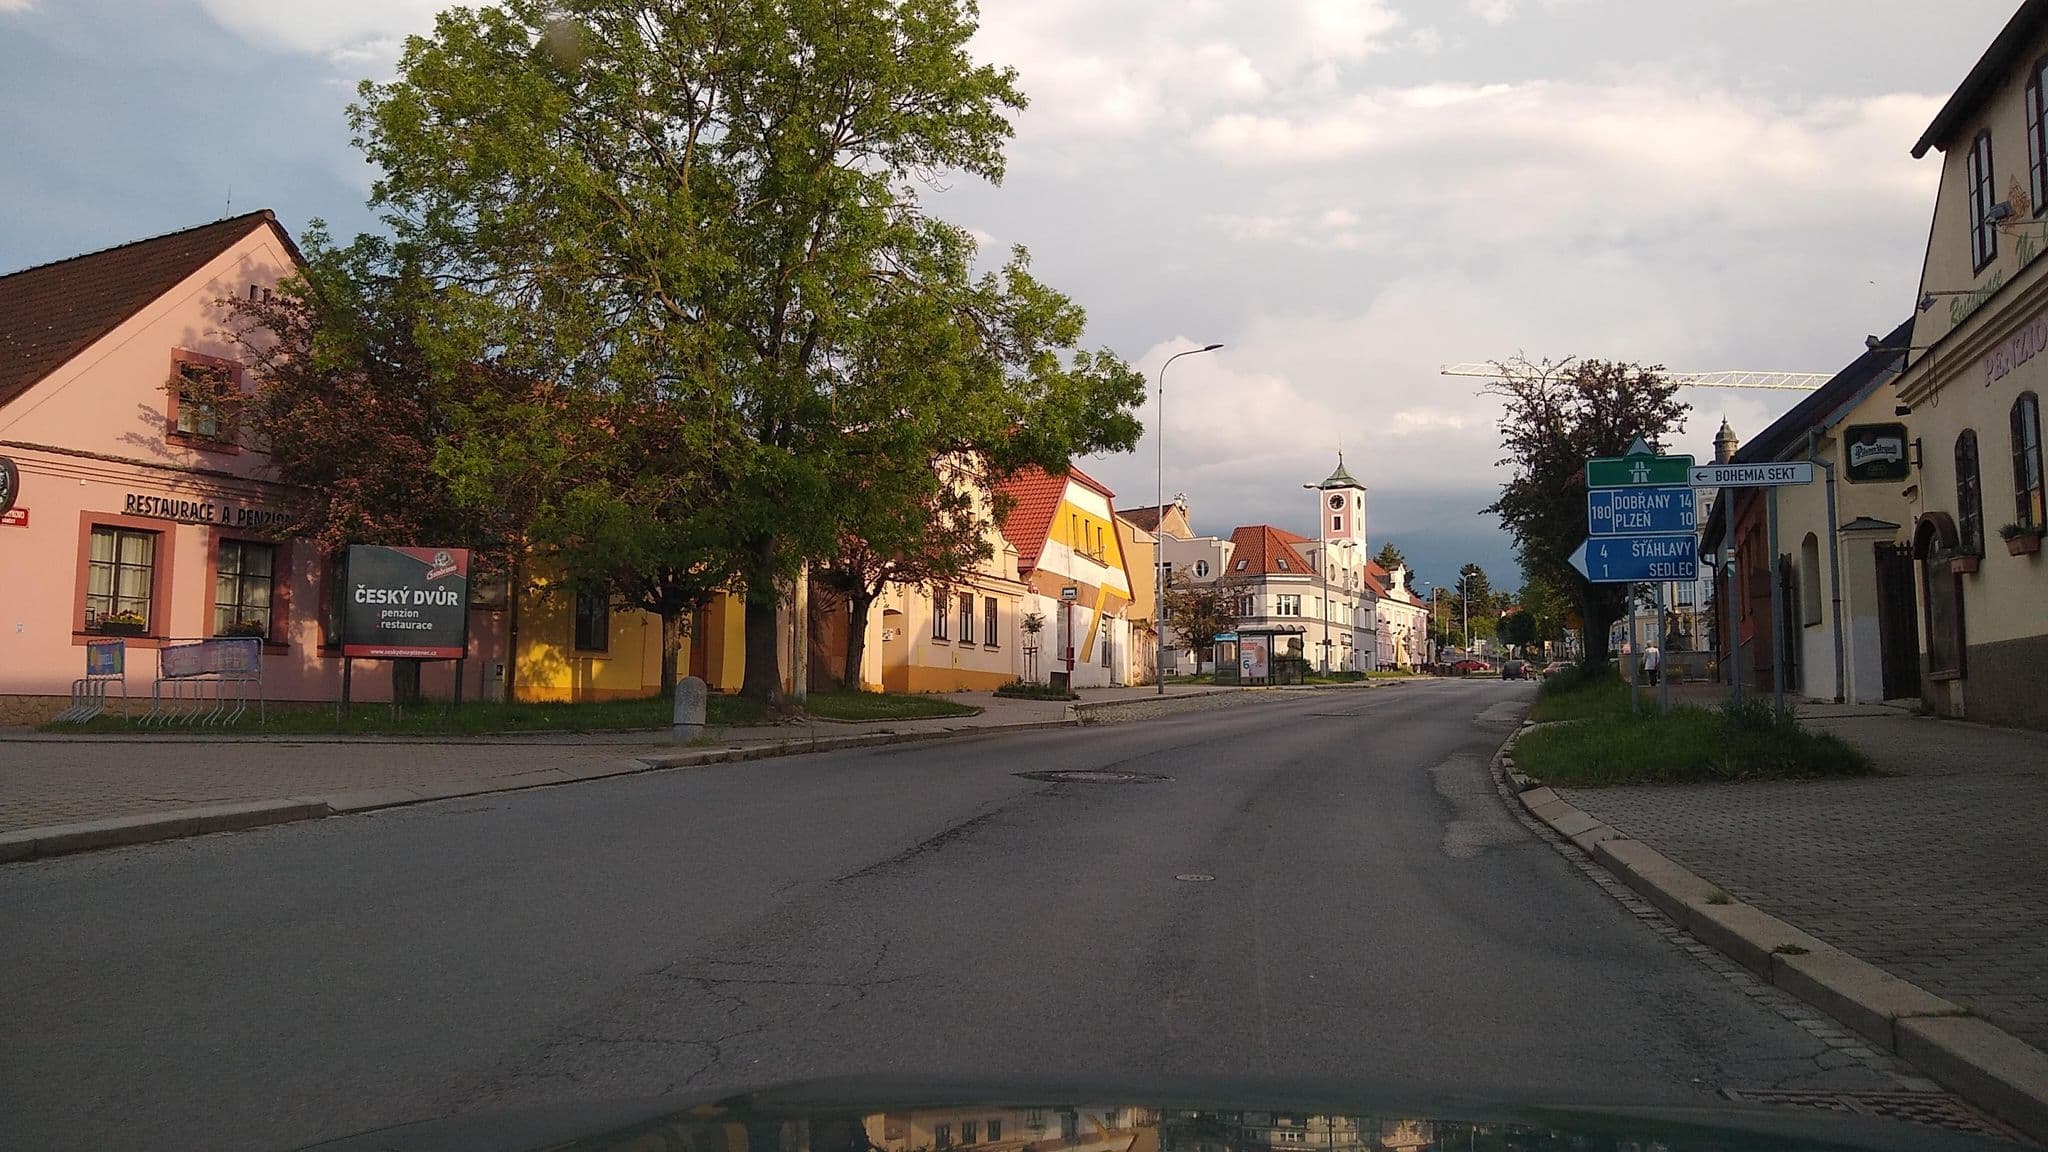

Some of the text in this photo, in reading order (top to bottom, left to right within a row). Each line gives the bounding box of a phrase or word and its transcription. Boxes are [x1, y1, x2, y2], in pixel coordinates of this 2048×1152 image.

[1715, 467, 1796, 482] BOHEMIA SEKT
[126, 493, 214, 521] RESTAURACE
[222, 506, 231, 524] A
[1614, 492, 1692, 510] DOBŘANY 14
[1591, 505, 1612, 520] 180
[1615, 509, 1693, 528] PLZEŇ 10
[1600, 539, 1691, 558] 4 ŠŤÁHLAVY
[1602, 562, 1693, 578] 1 SEDLEC
[355, 584, 458, 606] ČESKÝ DVŮR
[381, 609, 419, 619] penzion
[380, 620, 433, 630] restaurace
